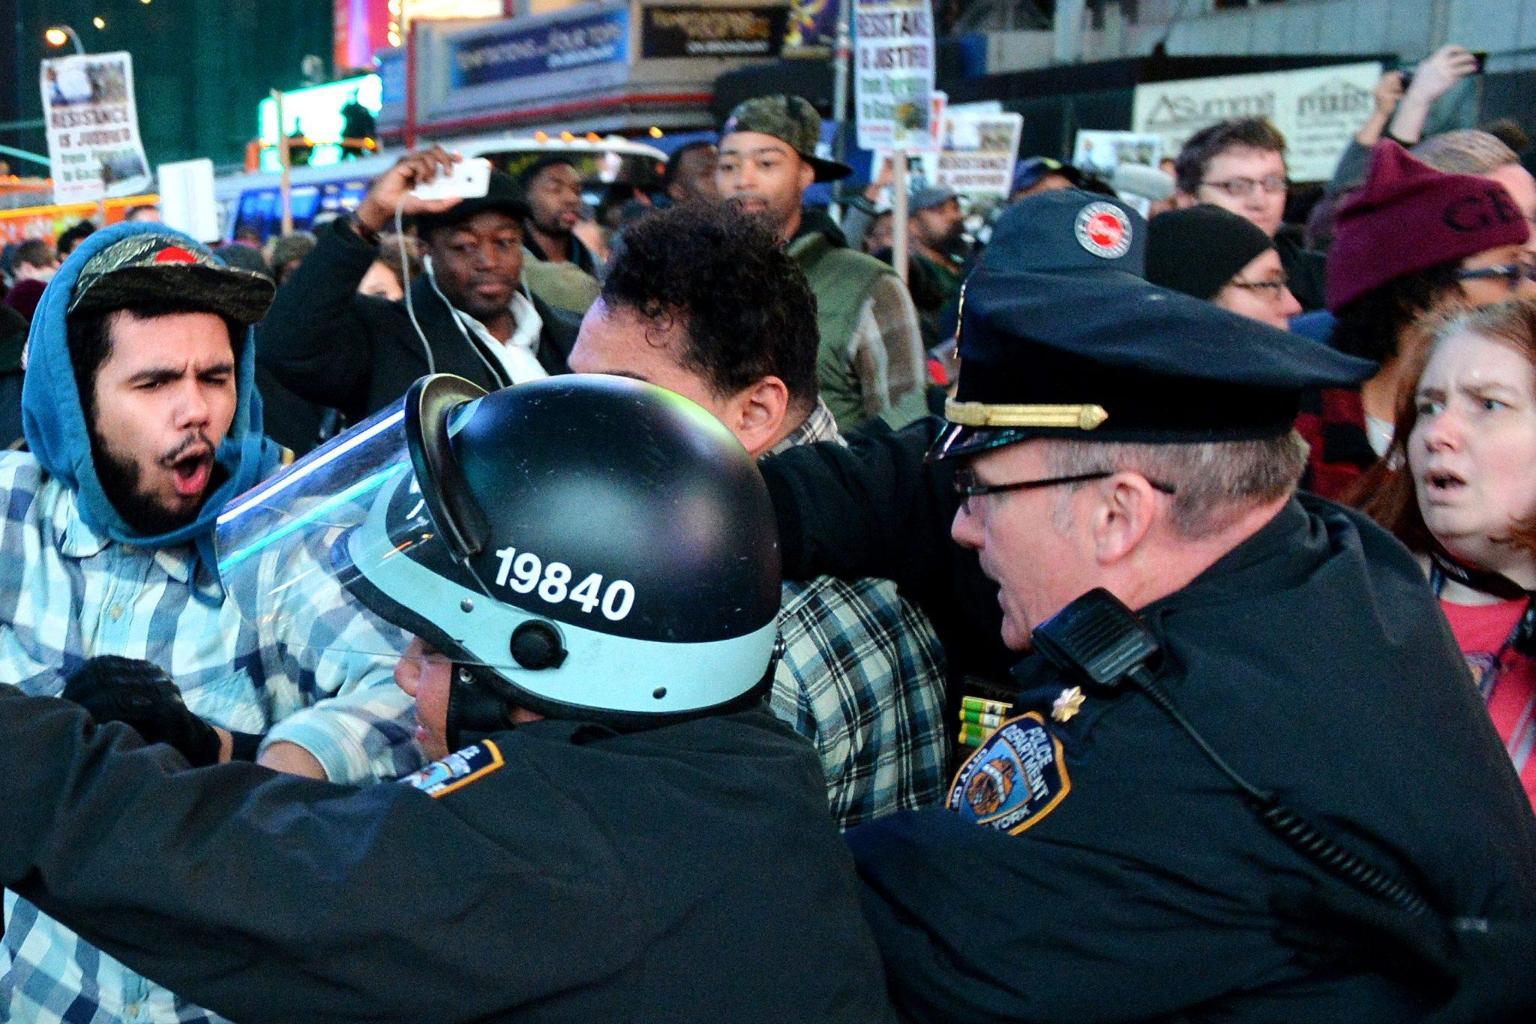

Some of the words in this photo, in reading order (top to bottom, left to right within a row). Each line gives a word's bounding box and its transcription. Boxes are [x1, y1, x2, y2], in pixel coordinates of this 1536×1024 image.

[495, 546, 636, 622] 19840
[1001, 724, 1049, 801] DEPARTMENT
[1024, 726, 1053, 769] POLICE
[992, 804, 1031, 831] YORK
